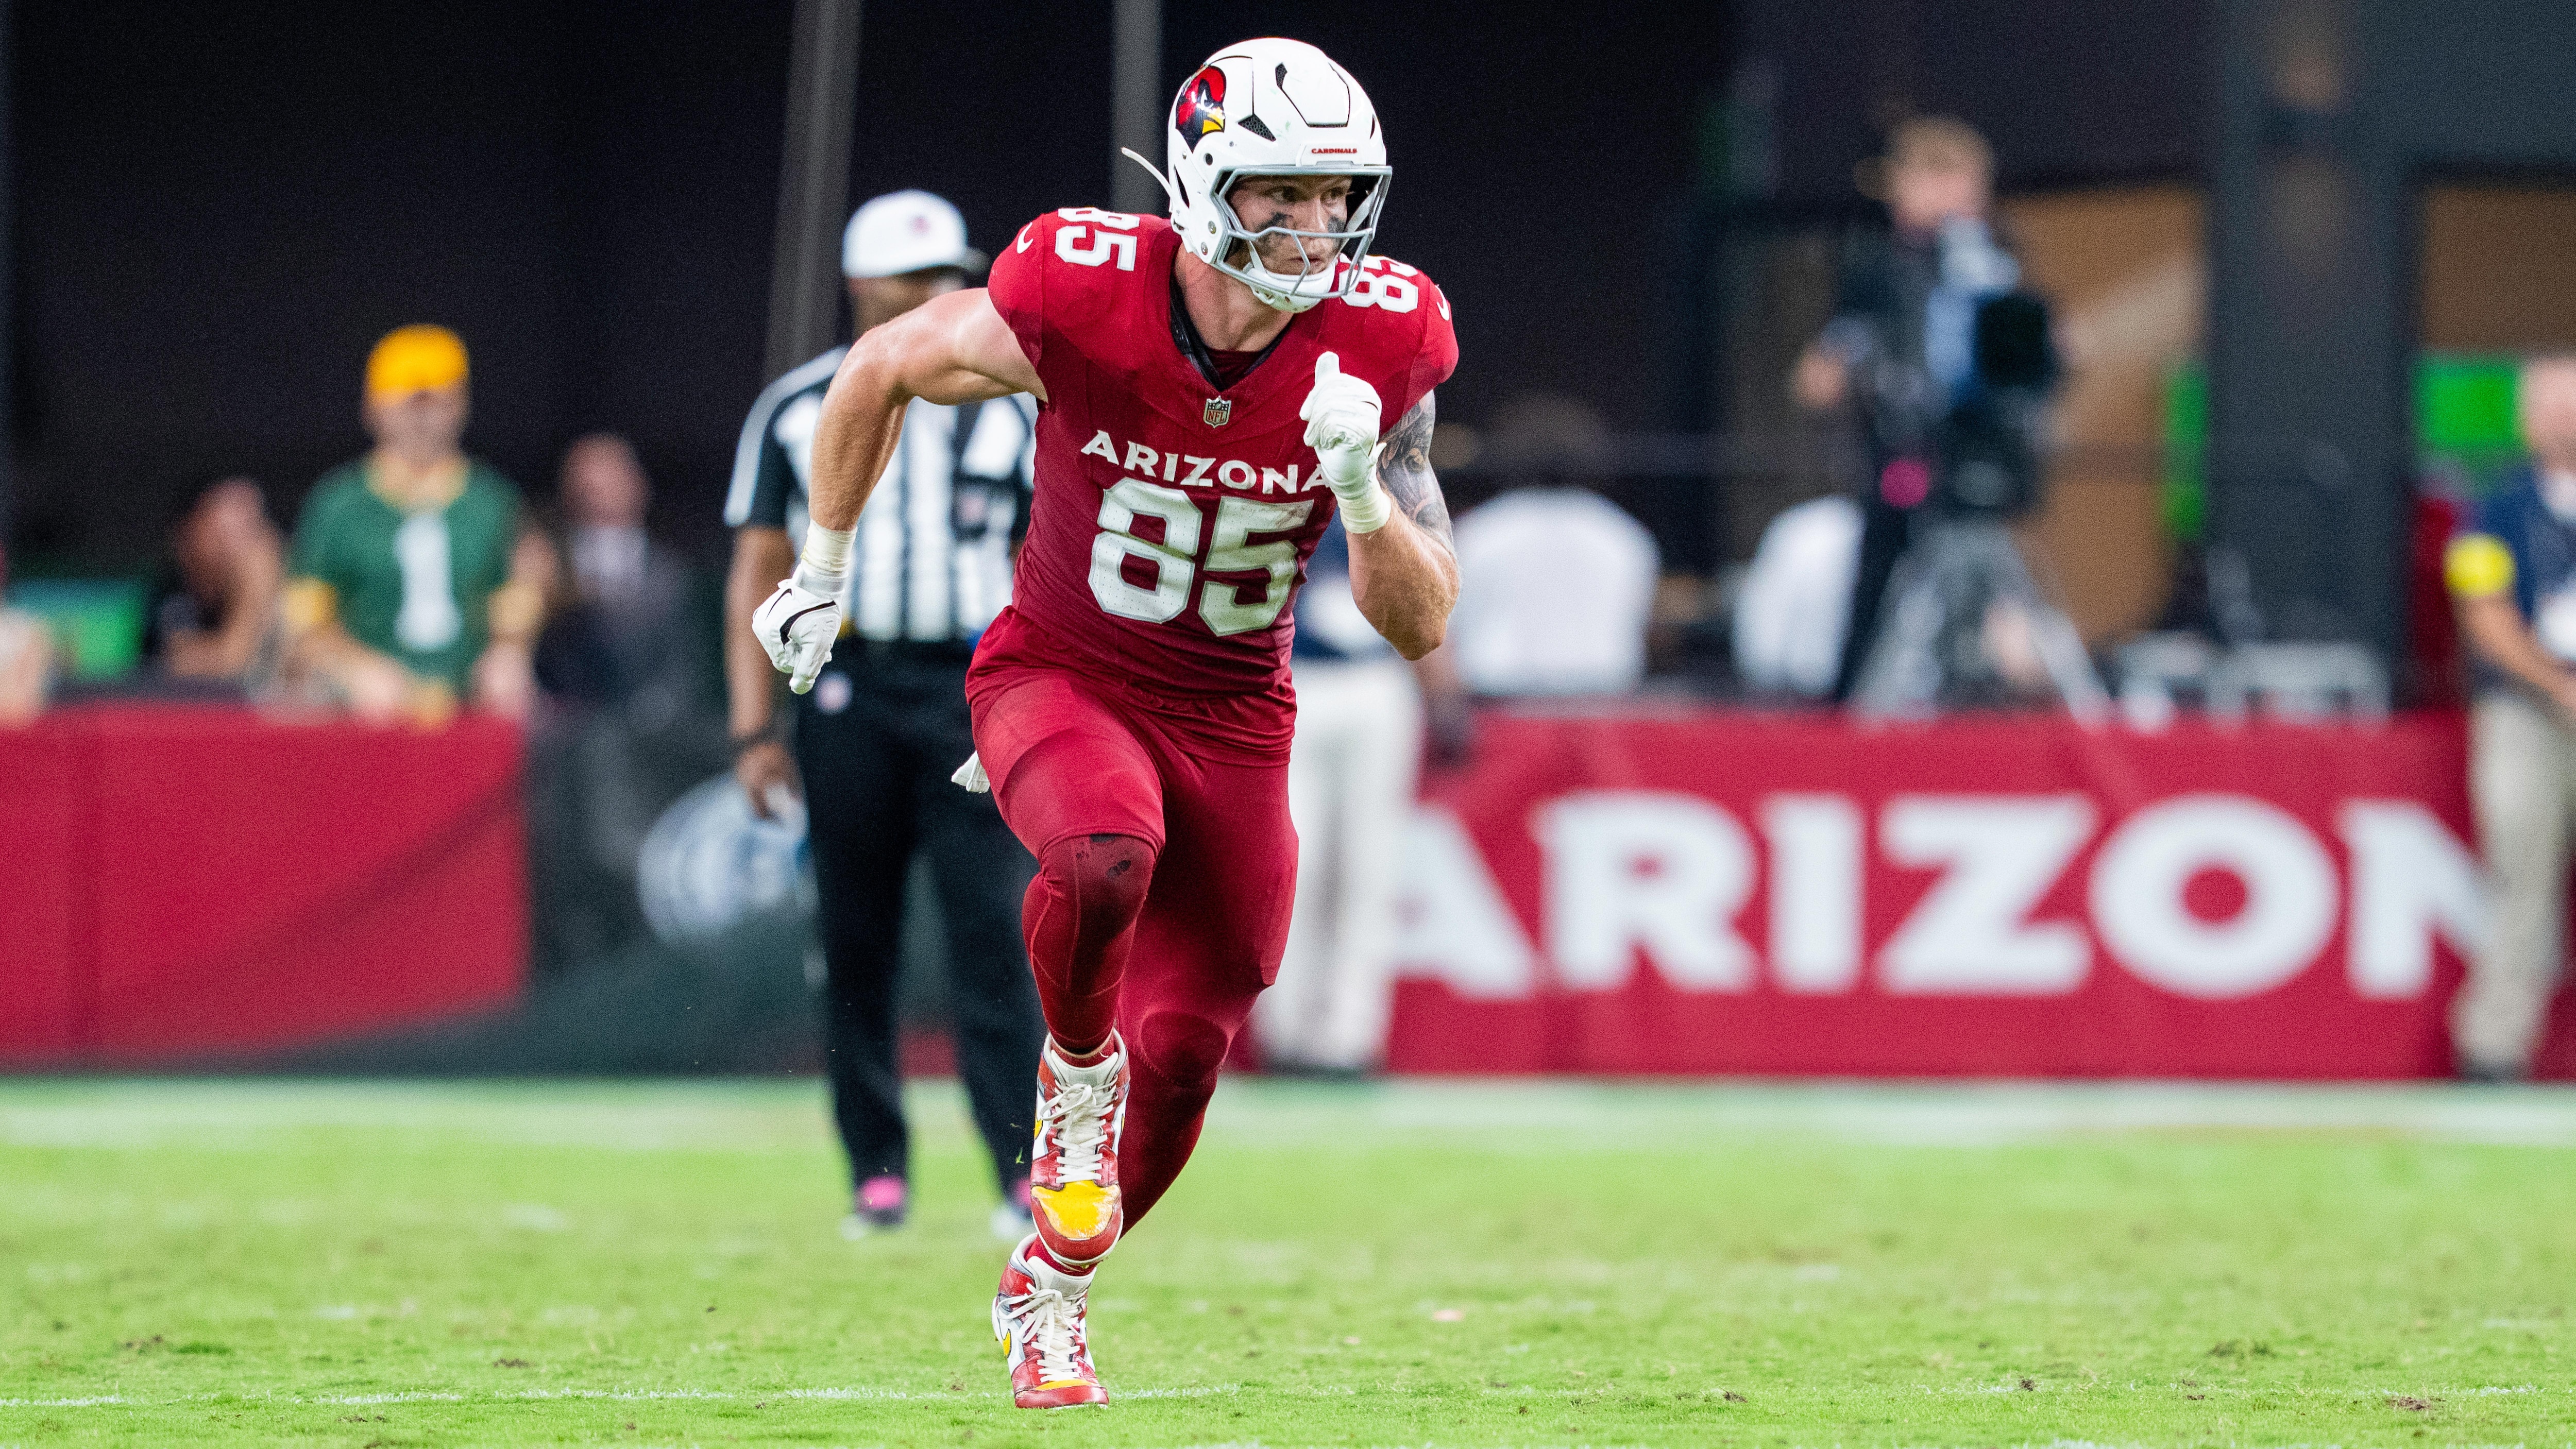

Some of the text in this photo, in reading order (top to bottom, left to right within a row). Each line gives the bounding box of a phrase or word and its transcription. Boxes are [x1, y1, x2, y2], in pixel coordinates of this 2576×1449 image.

[1055, 207, 1140, 271] 85
[1206, 410, 1227, 423] NFL
[1080, 430, 1331, 495] ARIZONA
[1088, 477, 1315, 637] 85
